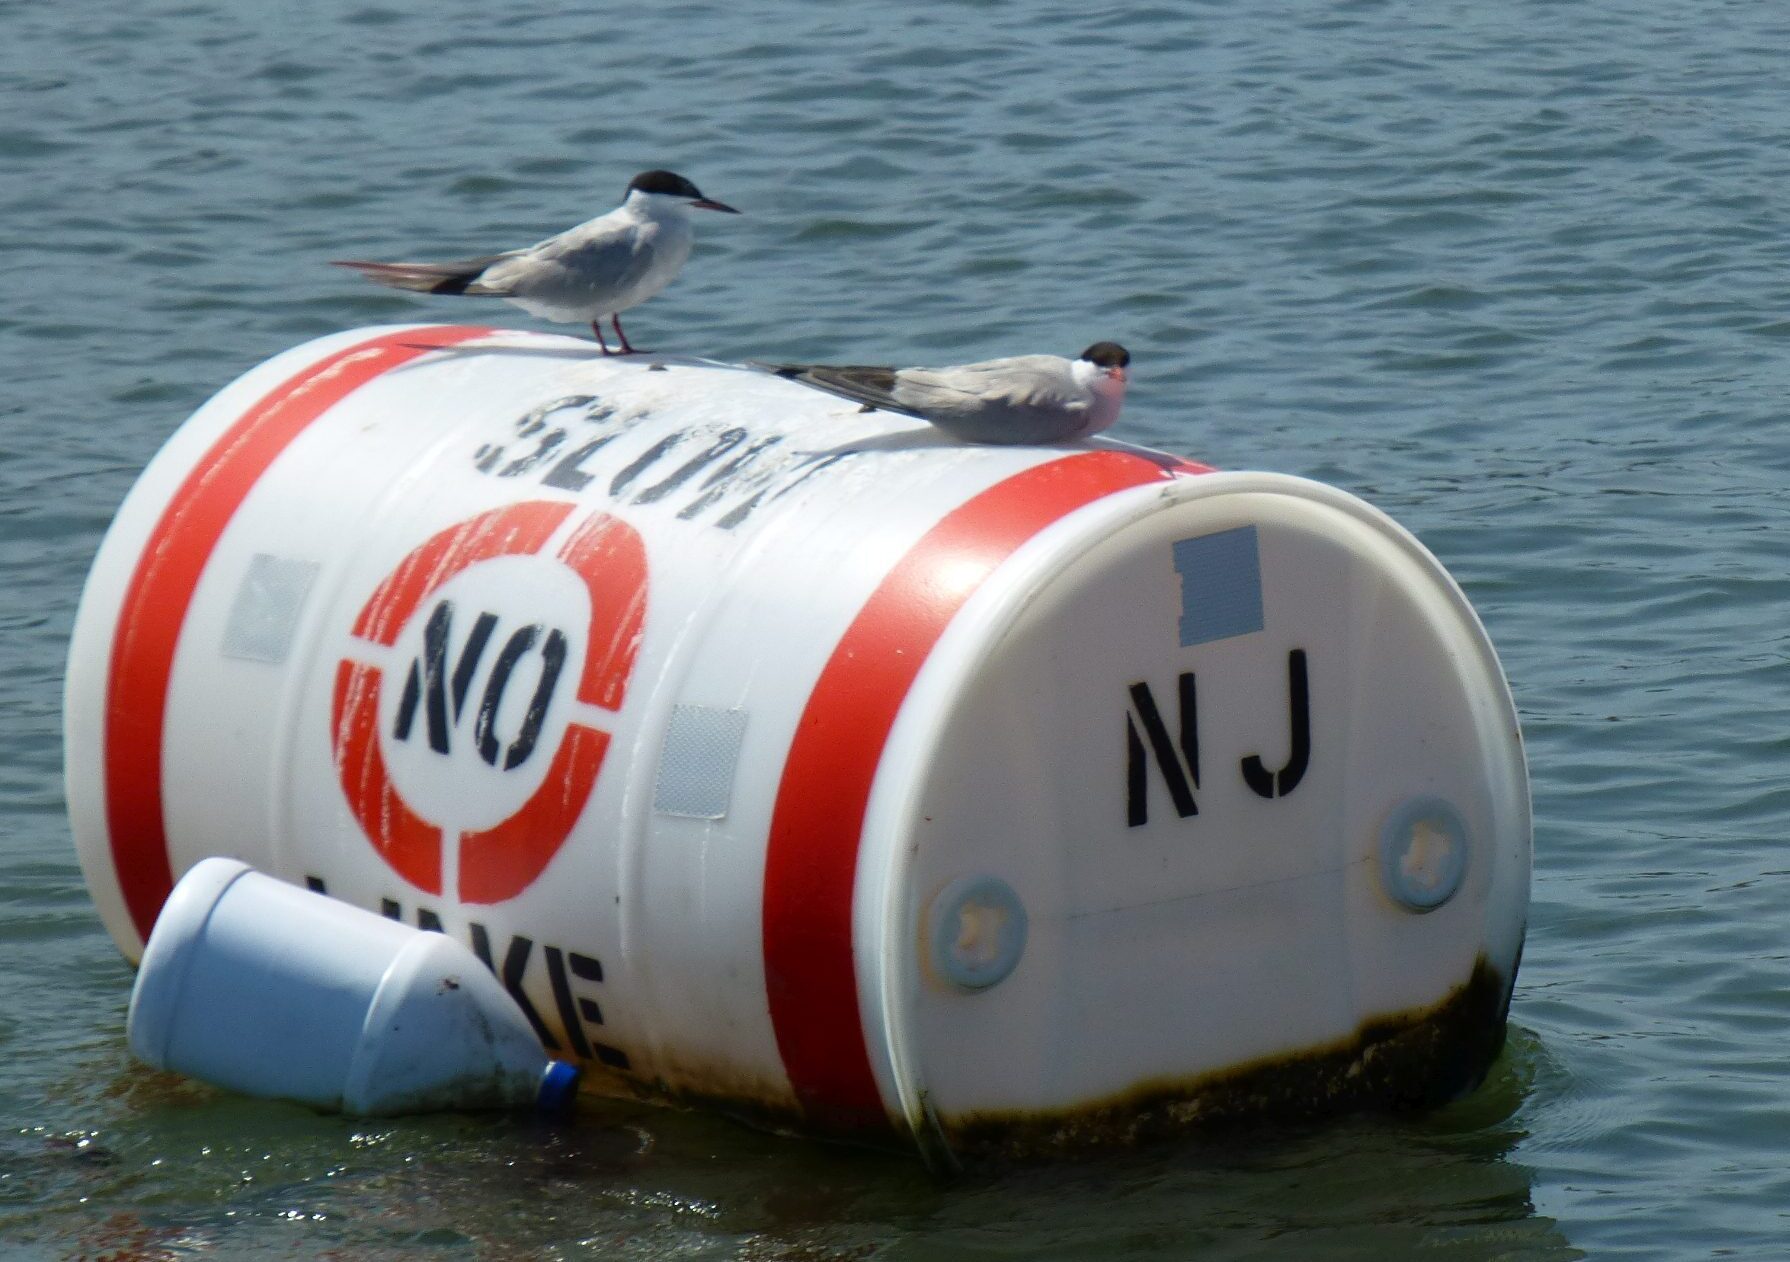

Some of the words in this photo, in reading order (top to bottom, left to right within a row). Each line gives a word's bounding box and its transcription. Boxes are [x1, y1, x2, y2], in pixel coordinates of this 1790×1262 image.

[393, 599, 567, 771] NO
[1127, 648, 1310, 827] NJ
[306, 875, 631, 1070] KE
